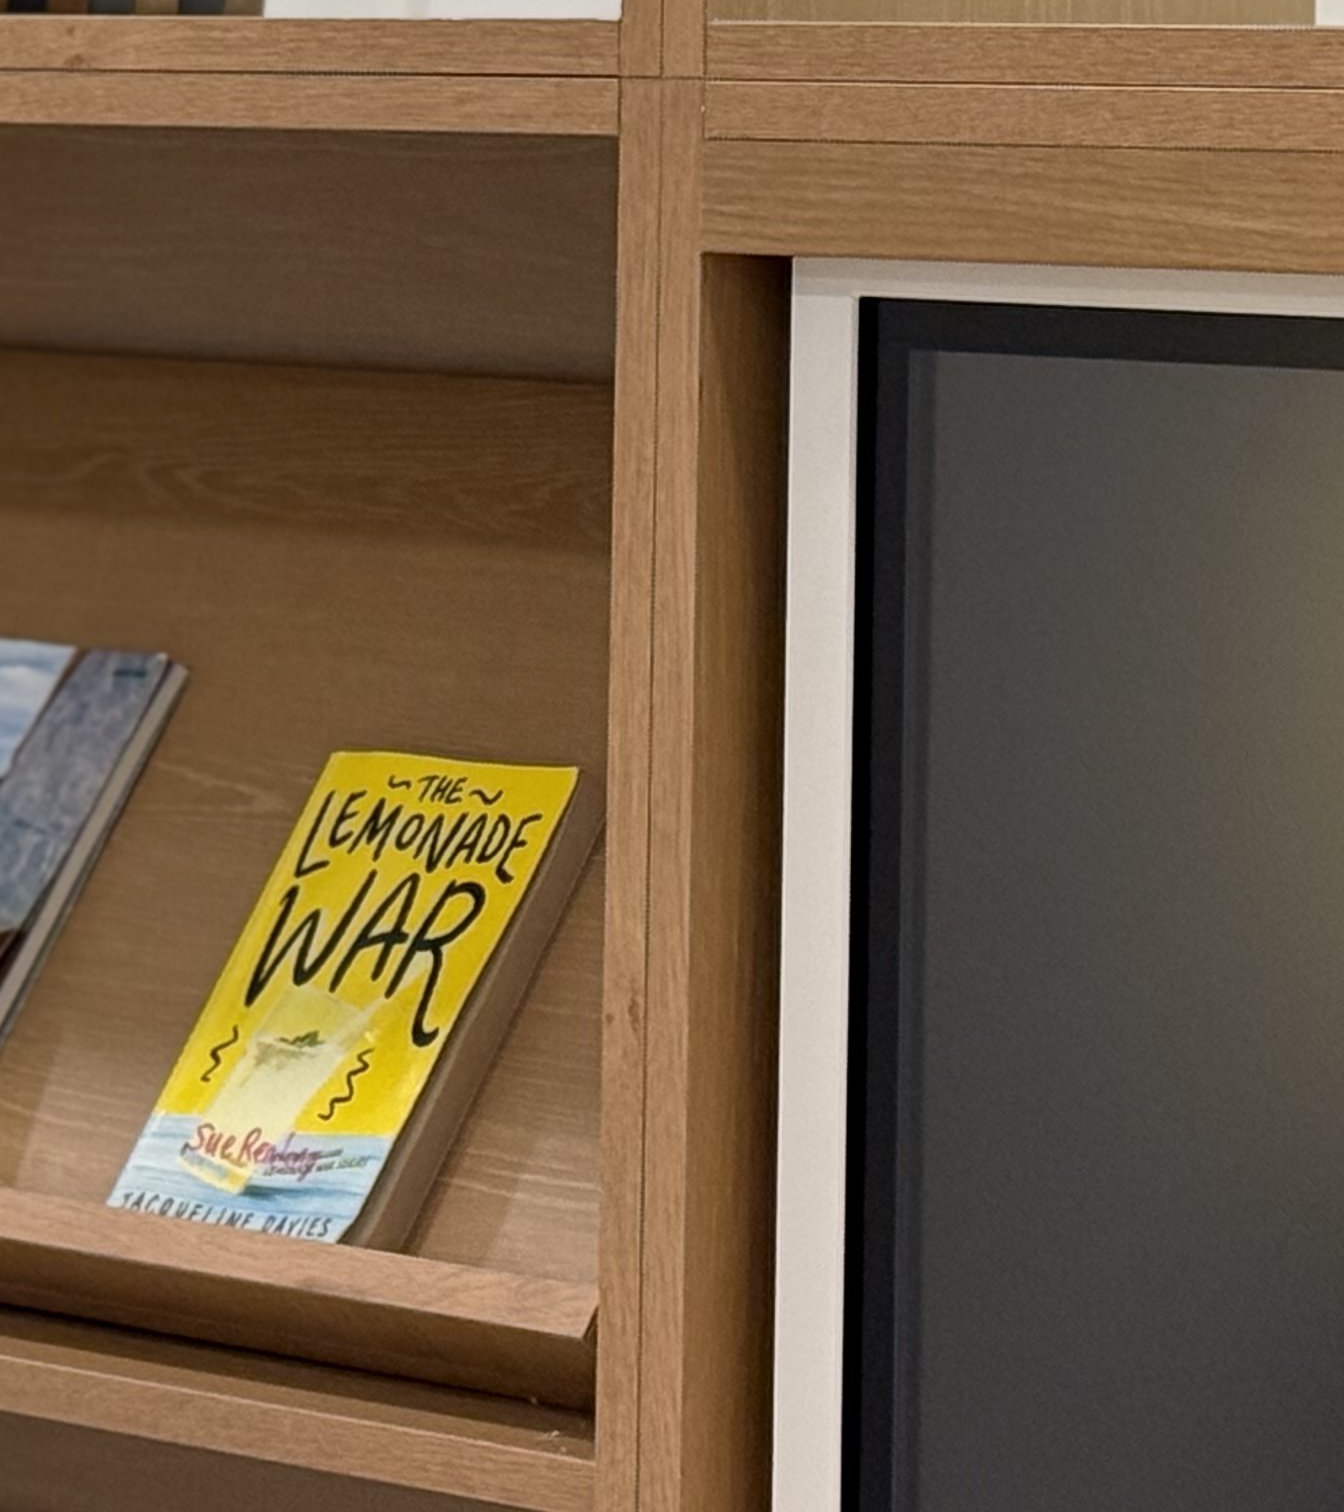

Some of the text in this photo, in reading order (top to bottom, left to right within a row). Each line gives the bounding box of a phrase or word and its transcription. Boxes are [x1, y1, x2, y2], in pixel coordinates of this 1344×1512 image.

[417, 774, 468, 804] THE
[294, 789, 544, 884] LEMONADE
[243, 869, 487, 1048] WAR
[261, 1214, 333, 1239] DAVIES
